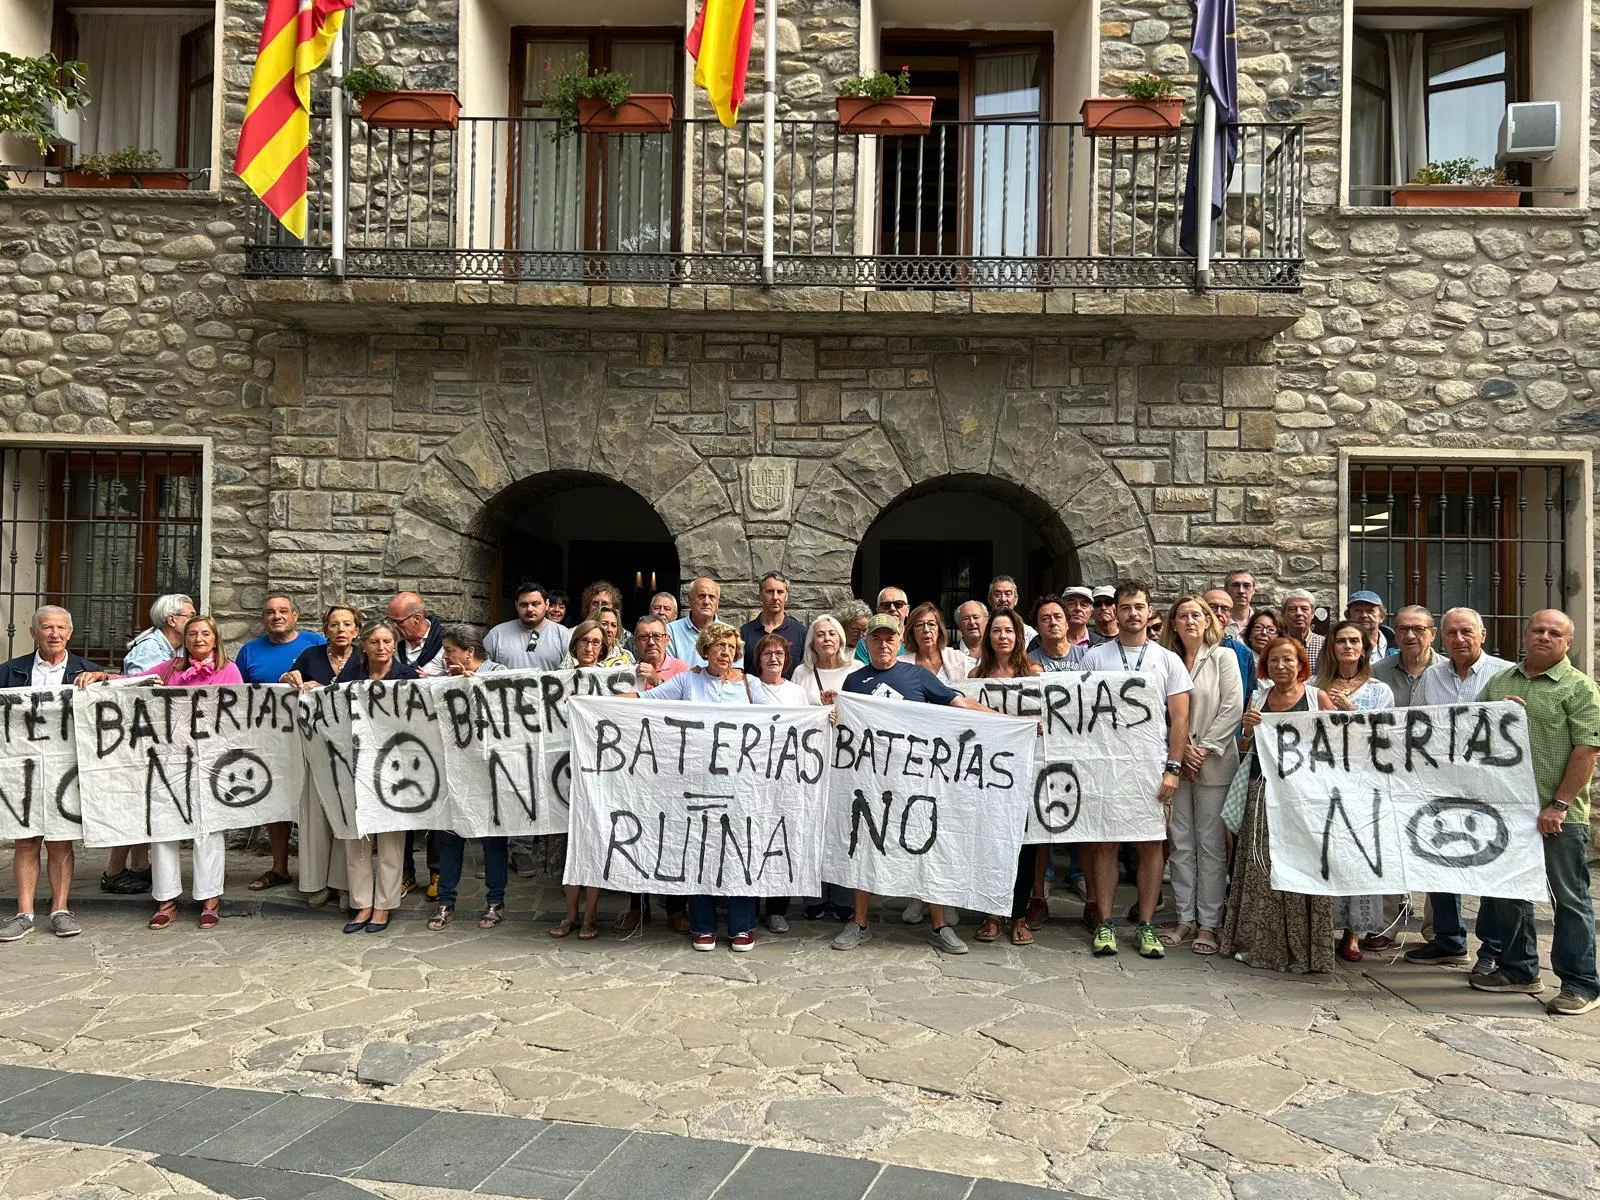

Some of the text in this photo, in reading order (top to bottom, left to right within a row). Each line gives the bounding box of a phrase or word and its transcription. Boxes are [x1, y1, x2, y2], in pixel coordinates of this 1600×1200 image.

[96, 684, 299, 758] BATERÍAS
[581, 714, 824, 784] BATERÍAS
[832, 724, 1015, 789] BATERÍAS
[1276, 705, 1523, 779] BATERÍAS
[848, 788, 938, 860] NO
